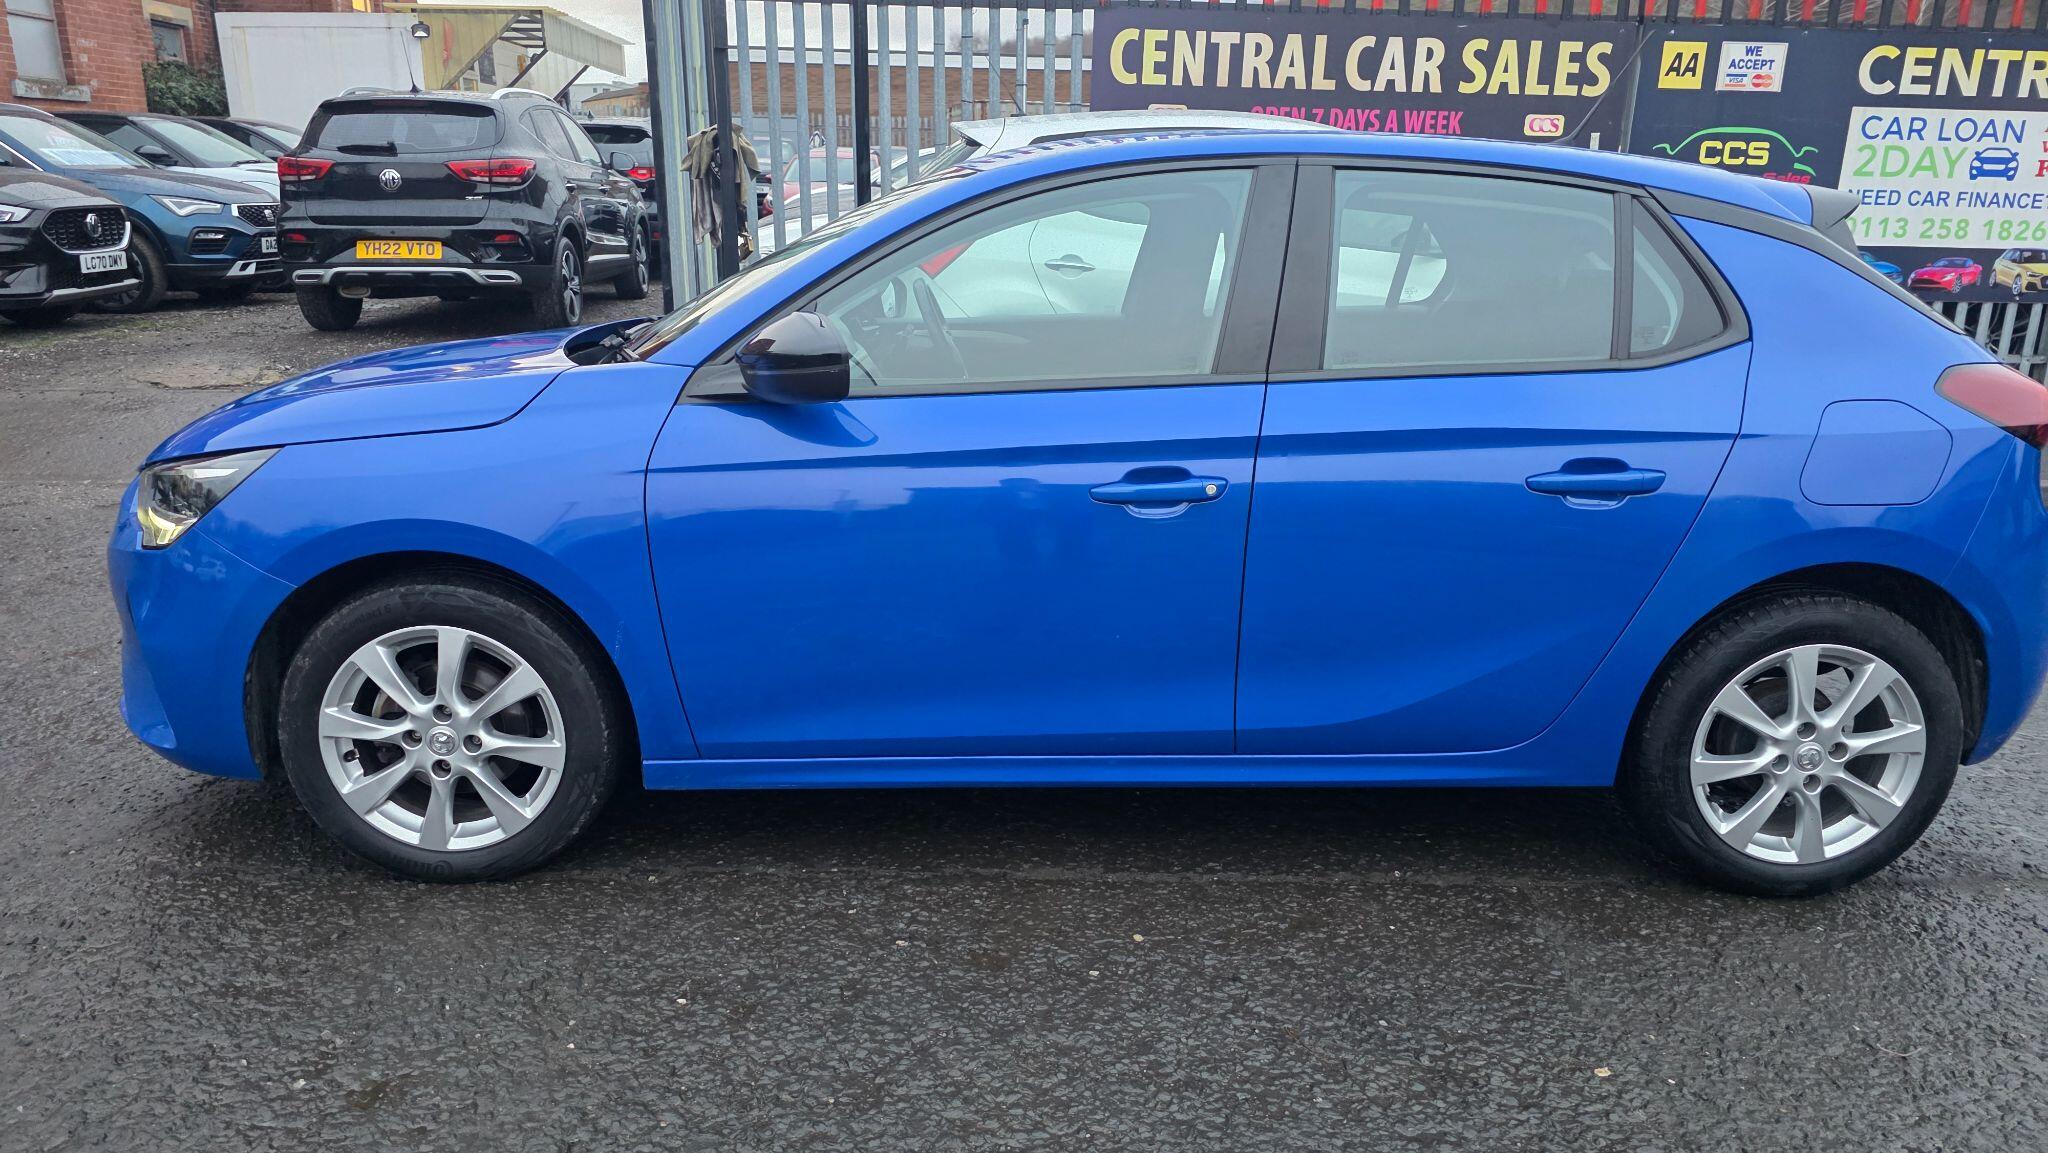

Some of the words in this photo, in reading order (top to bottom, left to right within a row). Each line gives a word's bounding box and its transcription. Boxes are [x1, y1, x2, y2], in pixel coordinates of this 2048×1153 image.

[1109, 28, 1337, 91] CENTRAL
[1344, 35, 1446, 93] CAR
[1458, 38, 1615, 97] SALES
[1745, 45, 1764, 57] WE
[1664, 52, 1700, 78] AA
[1728, 58, 1775, 71] ACCEPT
[1858, 45, 2048, 99] CENTR
[1329, 109, 1380, 131] DAYS
[1384, 113, 1398, 133] A
[1404, 111, 1464, 135] WEEK
[1528, 117, 1560, 133] CCS
[1861, 115, 1928, 141] CAR
[1937, 117, 2027, 144] LOAN
[1698, 140, 1770, 166] CCS
[1852, 144, 1969, 179] 2DAY
[1907, 190, 1950, 207] CAR
[1919, 217, 1970, 240] 258
[1983, 219, 2048, 242] 1826
[363, 242, 402, 256] YH22
[407, 242, 435, 256] VTO
